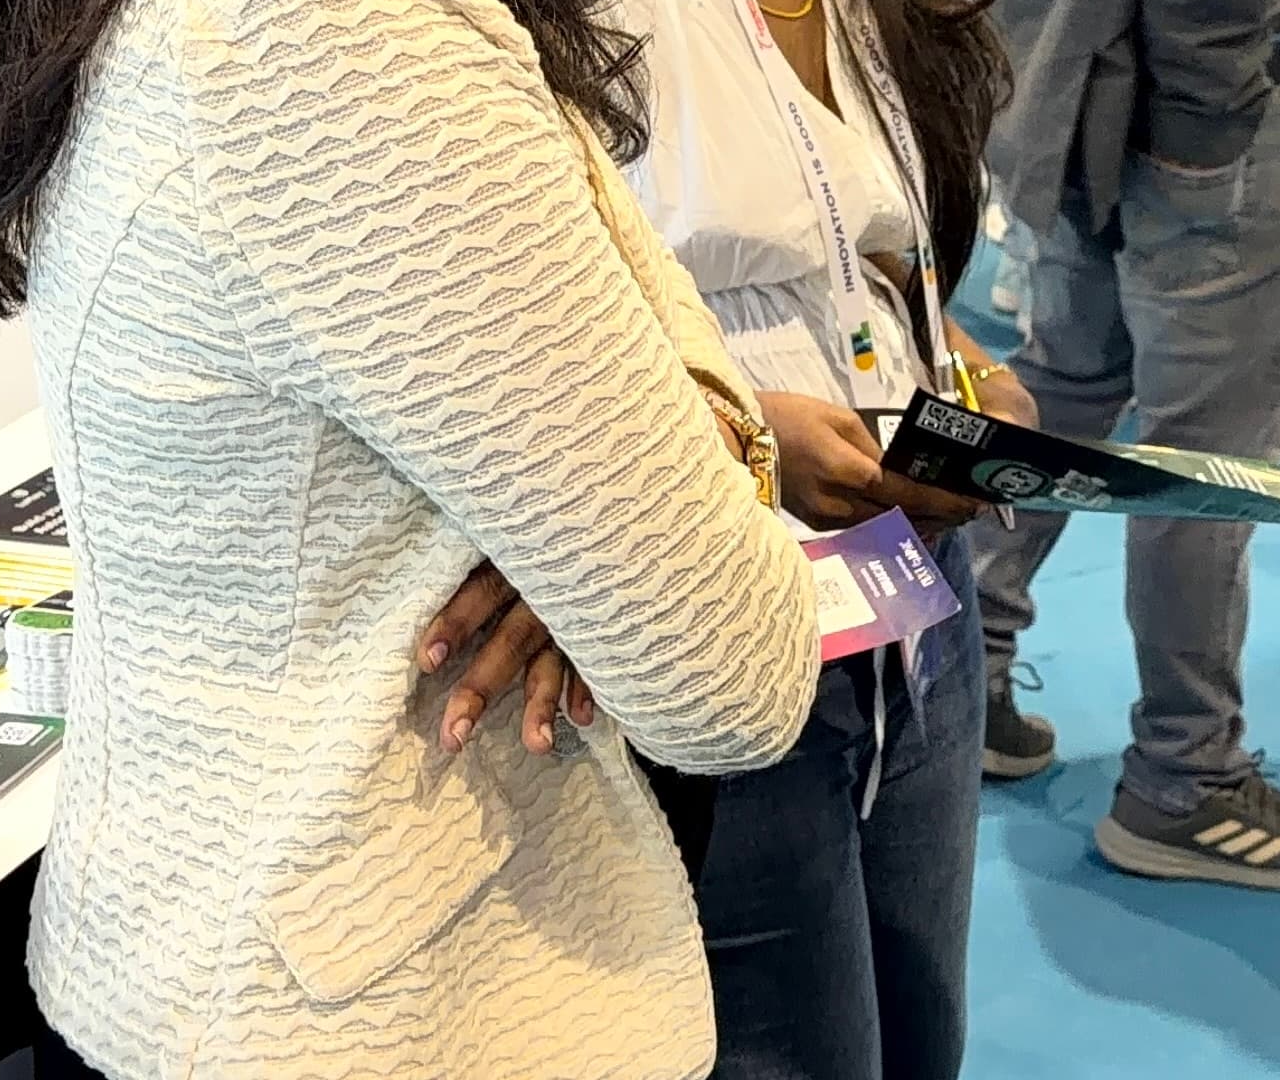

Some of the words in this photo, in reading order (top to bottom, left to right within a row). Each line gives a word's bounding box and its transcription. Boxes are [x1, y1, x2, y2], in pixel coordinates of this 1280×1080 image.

[788, 101, 814, 152] GOOD
[812, 158, 823, 176] IS
[820, 182, 856, 294] INNOVATION
